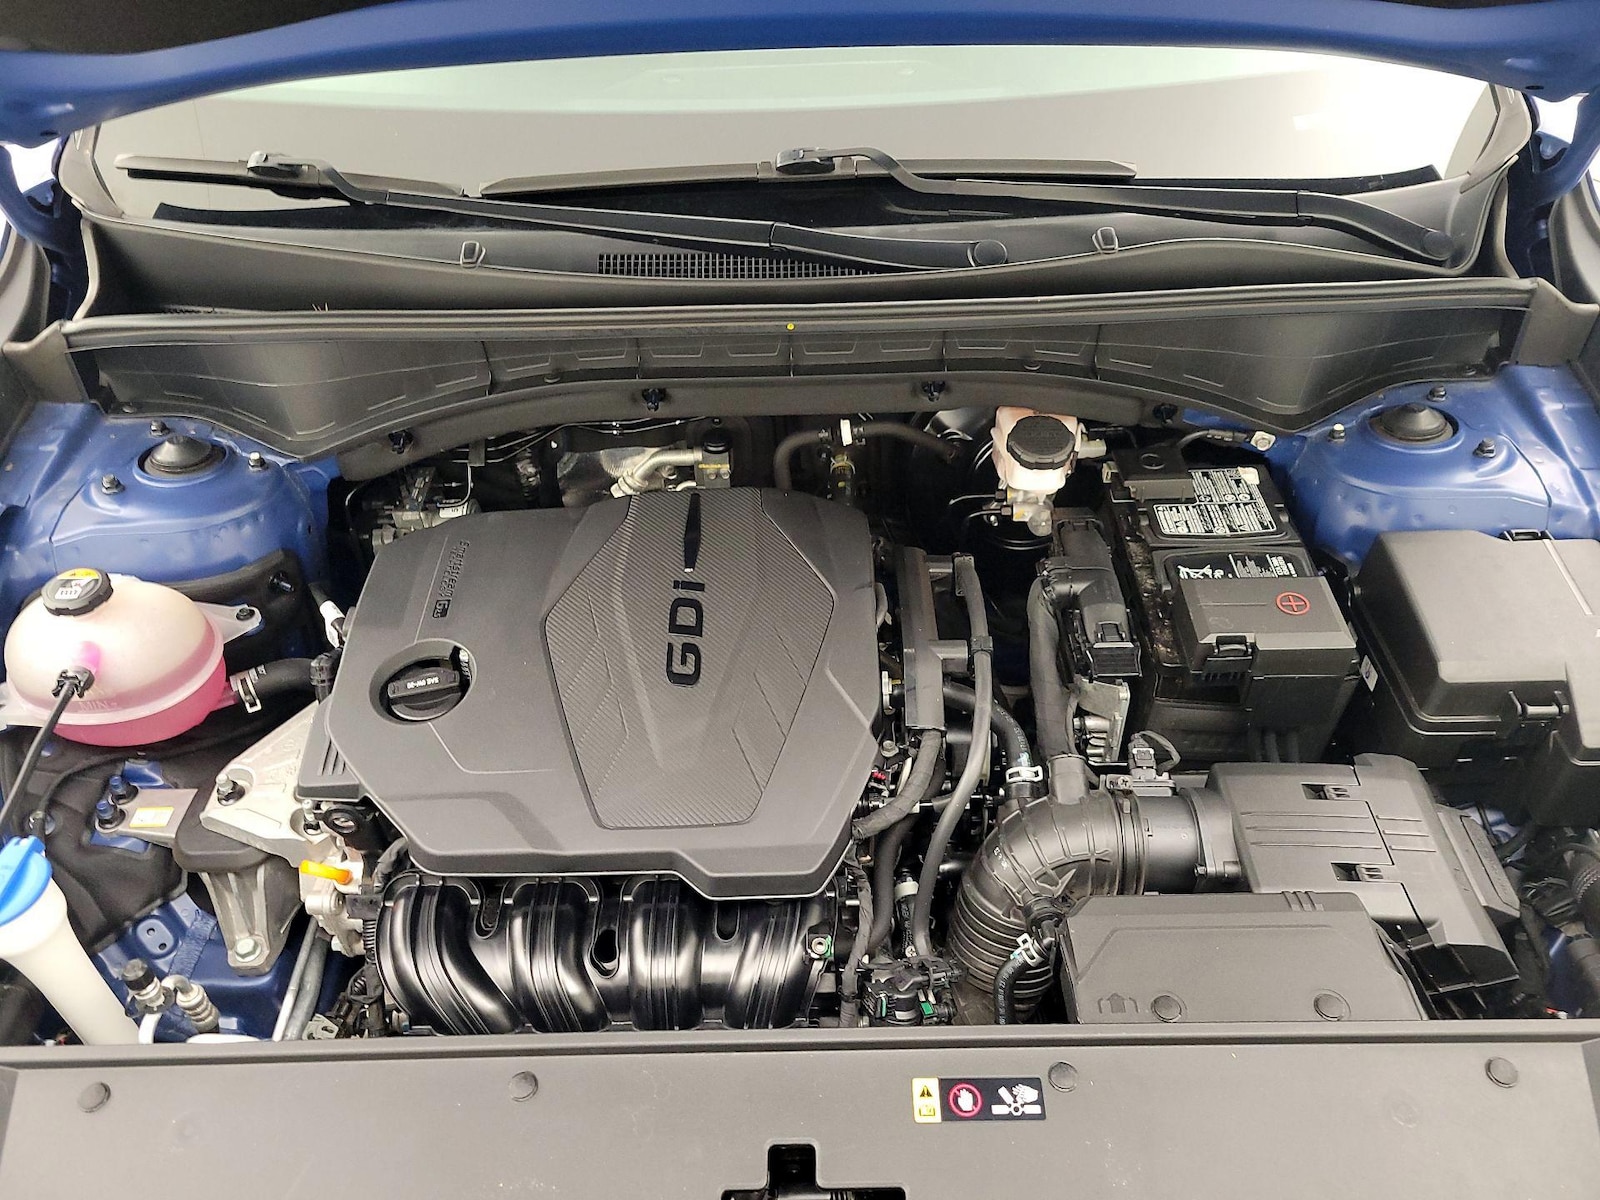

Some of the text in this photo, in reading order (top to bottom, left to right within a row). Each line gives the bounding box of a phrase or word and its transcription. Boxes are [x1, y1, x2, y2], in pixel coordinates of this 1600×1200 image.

[445, 540, 470, 597] Smartstream
[666, 580, 705, 686] GDi
[426, 676, 440, 686] SAE
